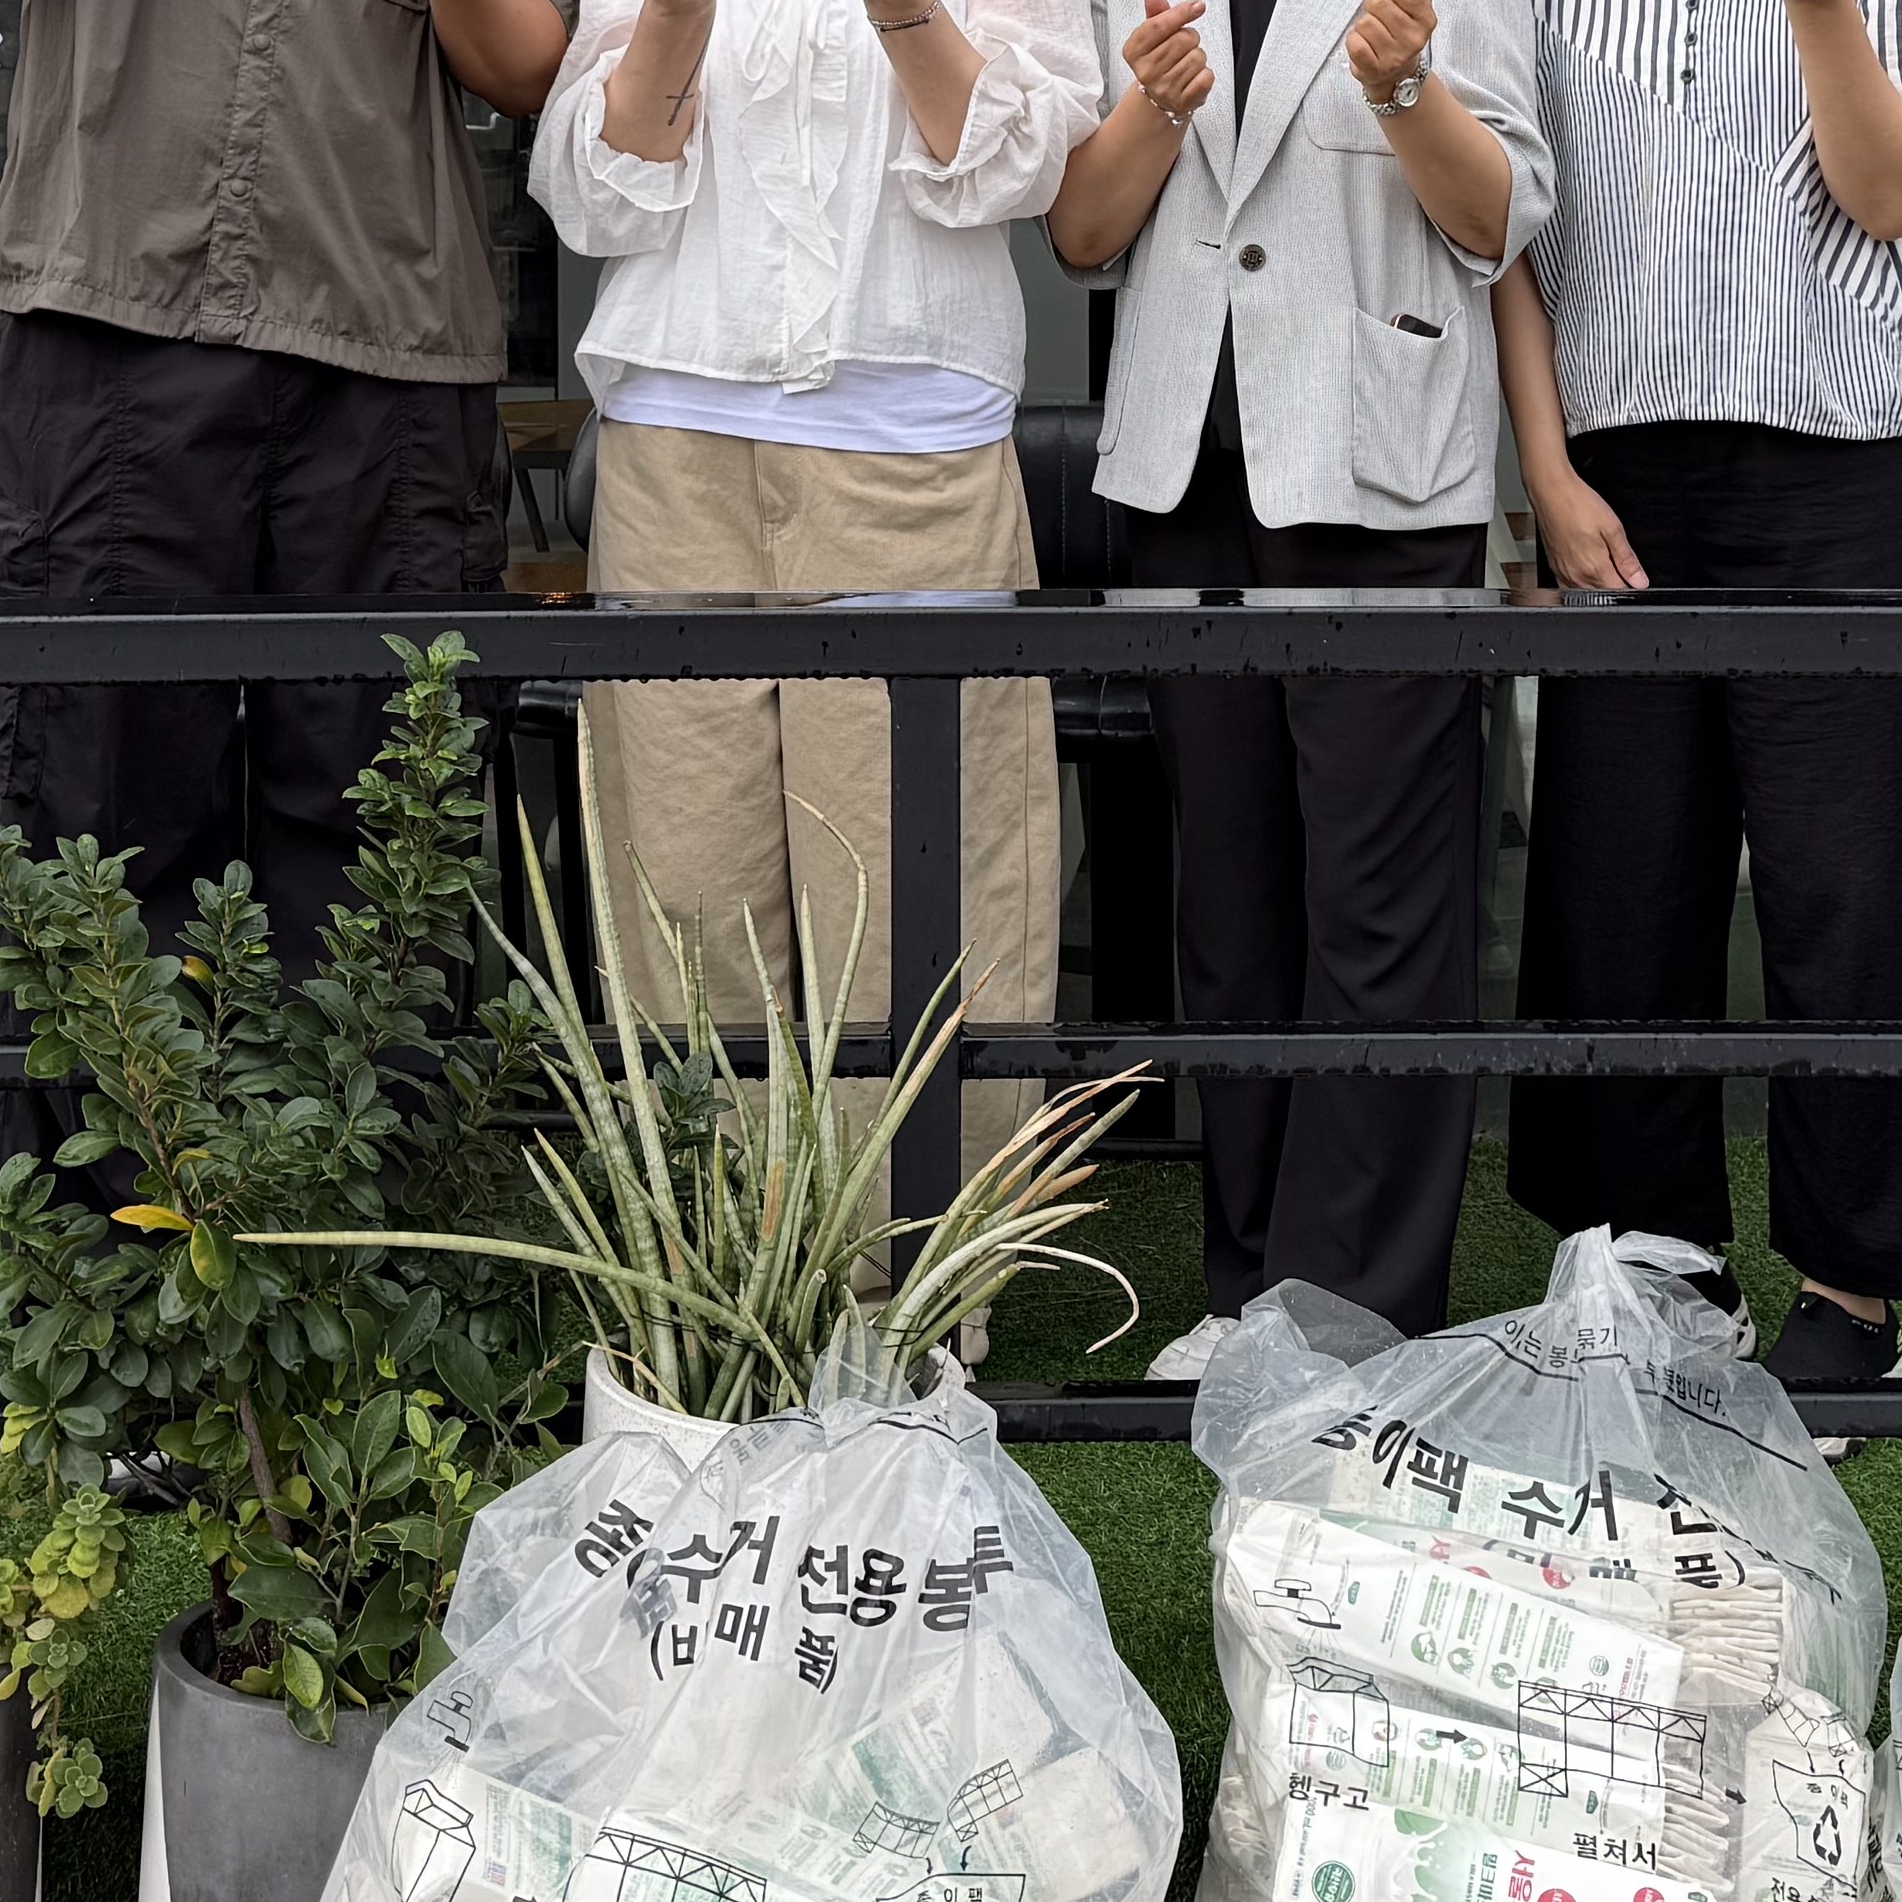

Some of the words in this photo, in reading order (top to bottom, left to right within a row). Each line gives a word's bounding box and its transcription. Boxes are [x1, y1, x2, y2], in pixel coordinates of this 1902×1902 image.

[1501, 1470, 1618, 1541] 수거
[799, 1544, 907, 1628] 전용
[1288, 1772, 1370, 1811] 헹구고
[1571, 1830, 1659, 1873] 펼쳐서
